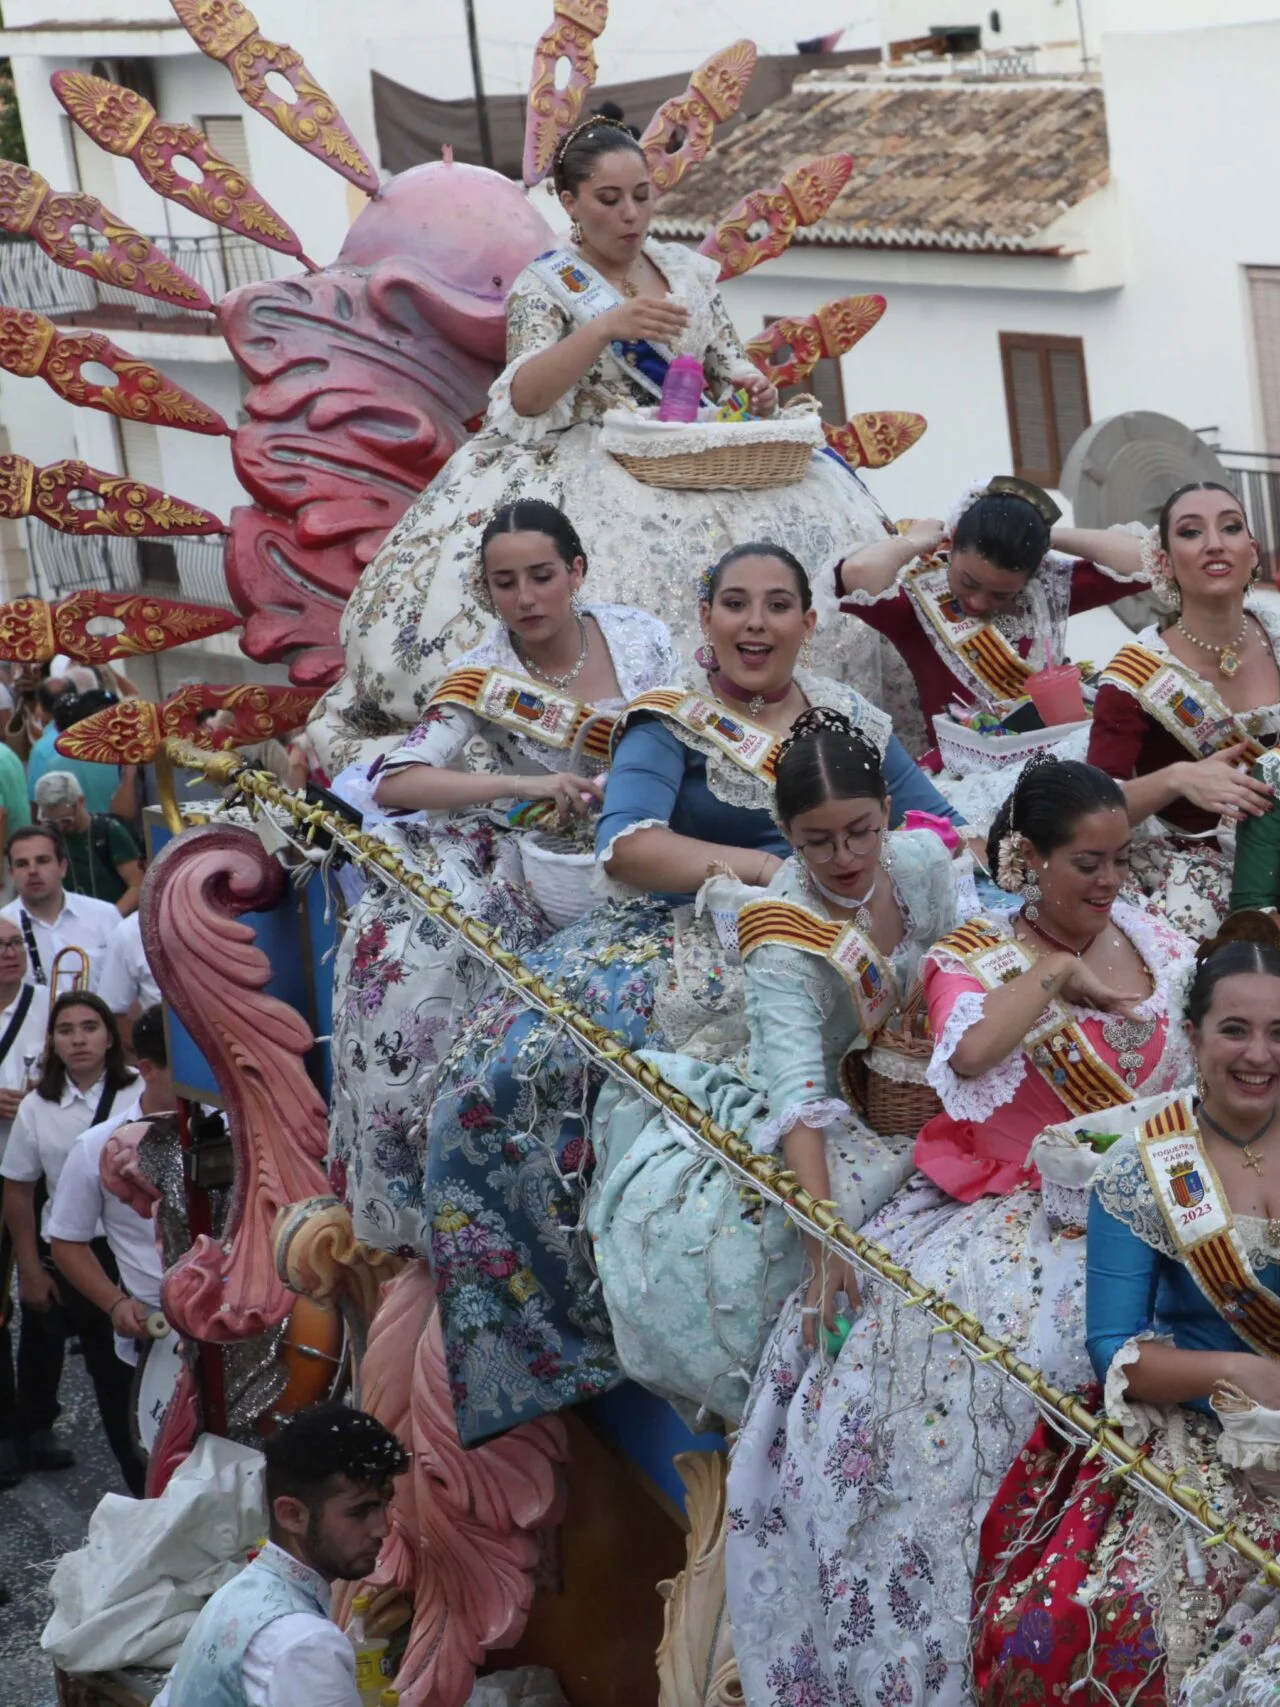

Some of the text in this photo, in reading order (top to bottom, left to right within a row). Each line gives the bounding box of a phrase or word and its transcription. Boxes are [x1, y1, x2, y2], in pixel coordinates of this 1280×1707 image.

[1192, 716, 1216, 740] 2023
[739, 734, 757, 754] 2023
[981, 951, 1016, 969] FOGUERES
[1152, 1143, 1195, 1159] FOGUERES
[1181, 1203, 1212, 1225] 2023
